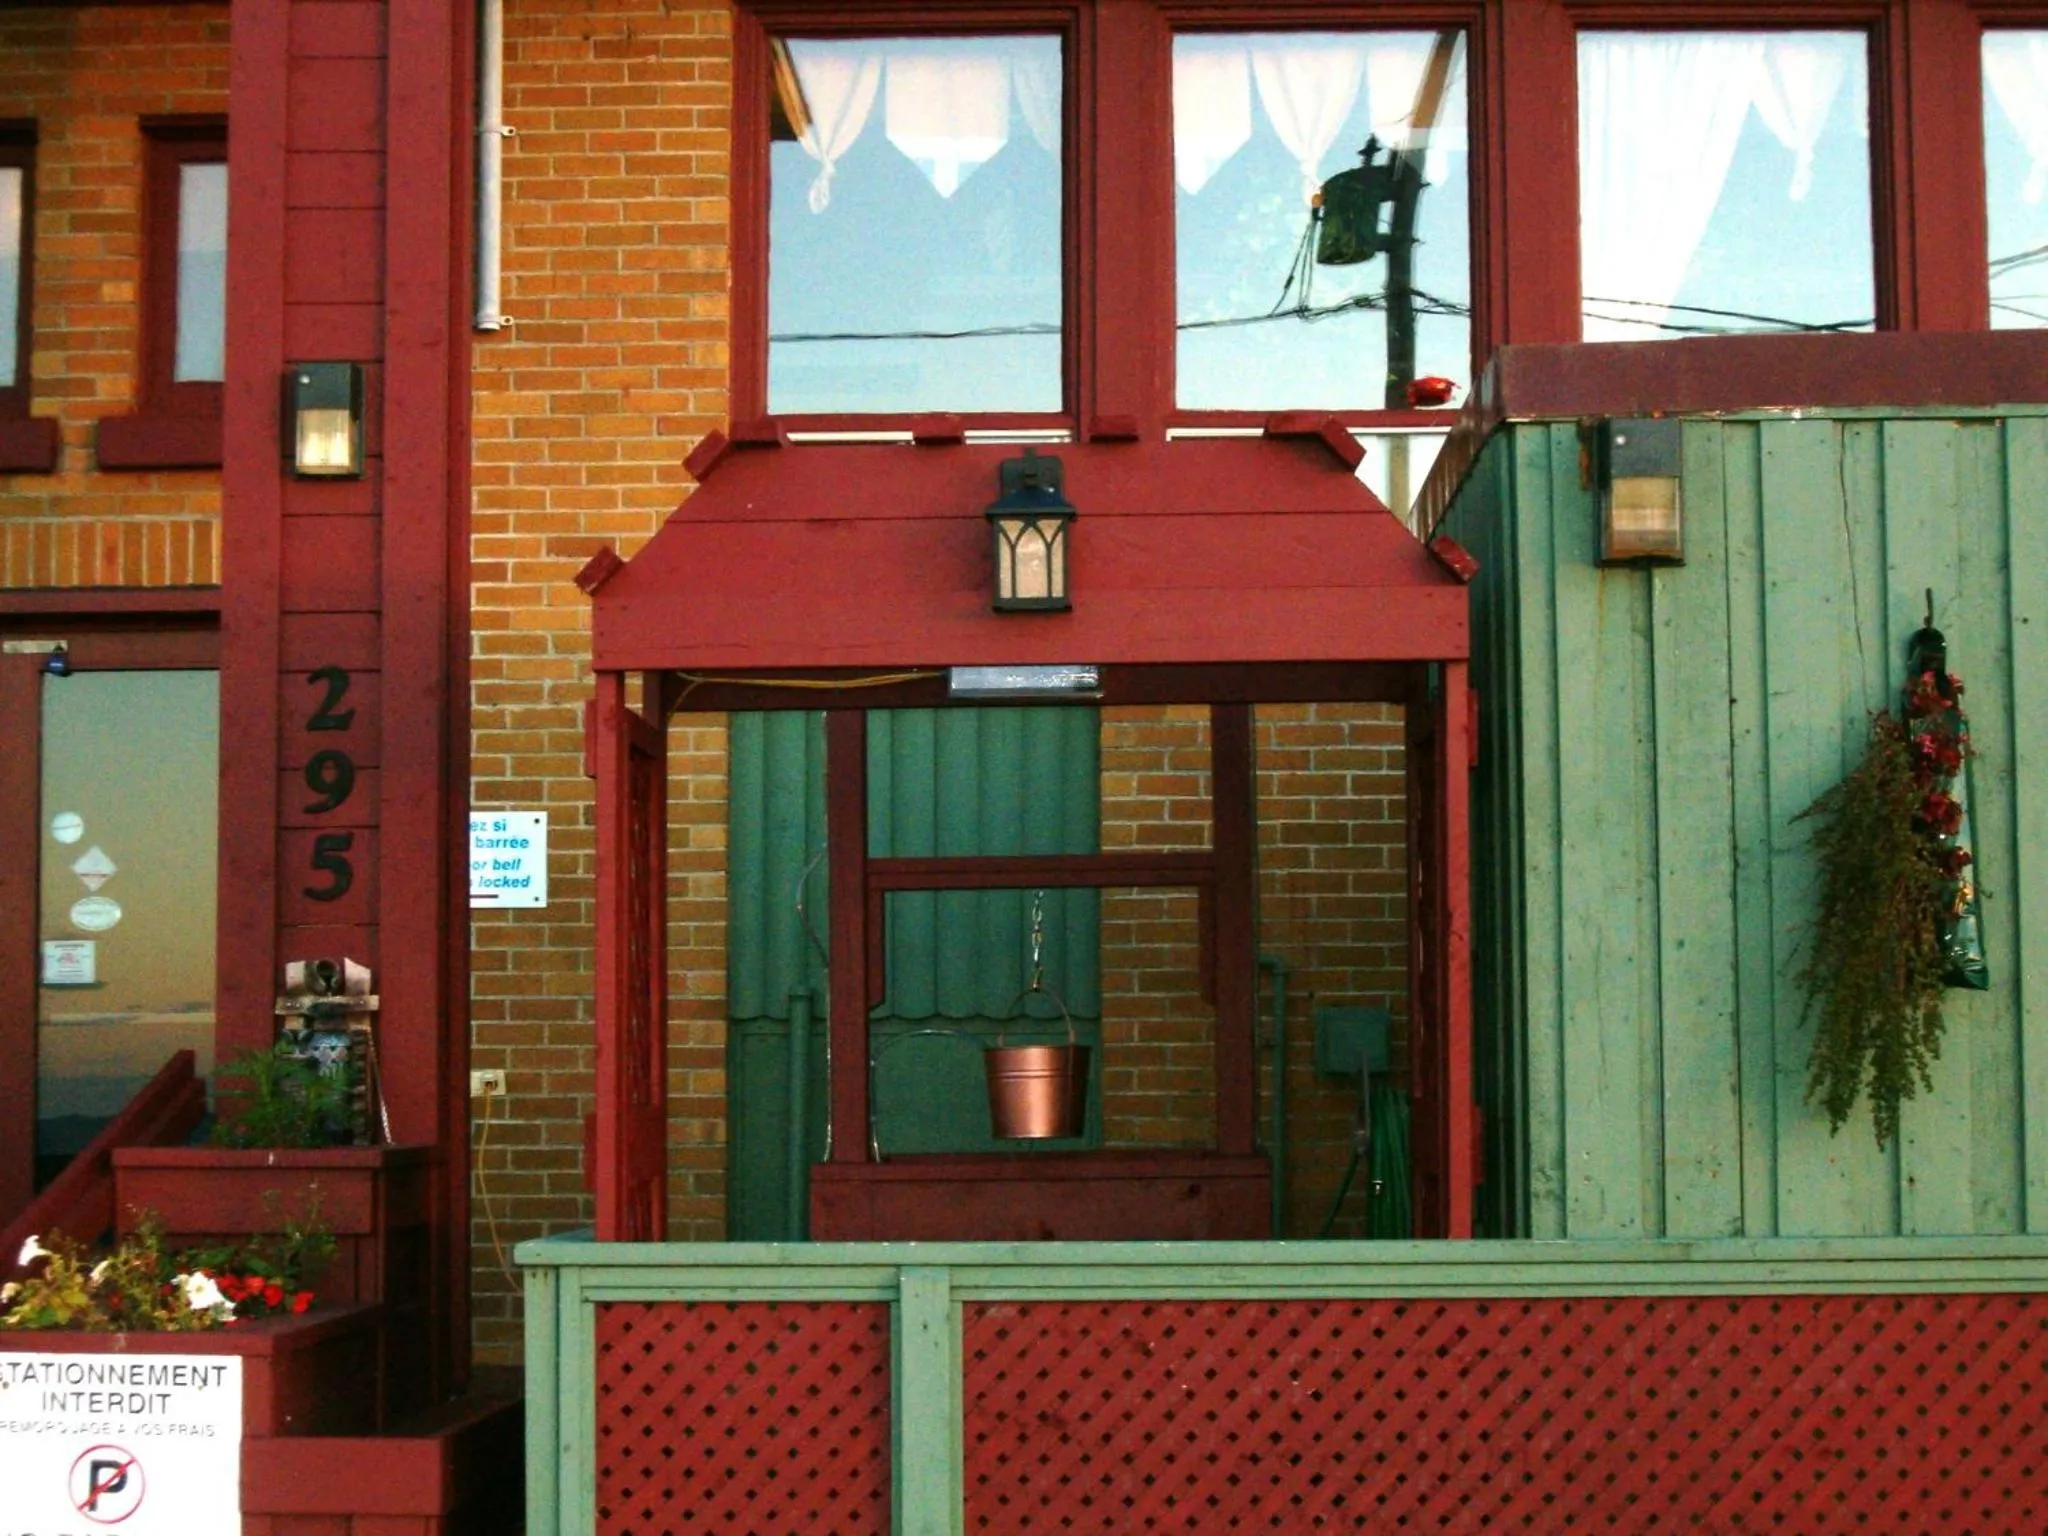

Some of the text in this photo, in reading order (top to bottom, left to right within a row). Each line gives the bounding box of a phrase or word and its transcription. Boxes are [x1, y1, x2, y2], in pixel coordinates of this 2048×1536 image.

[303, 665, 355, 902] 295
[470, 819, 507, 832] ez si
[471, 858, 522, 871] or bell
[478, 875, 531, 888] locked
[42, 1391, 171, 1414] INTERDIT
[0, 1420, 111, 1436] REMORQAGE
[168, 1422, 216, 1439] FRAIS
